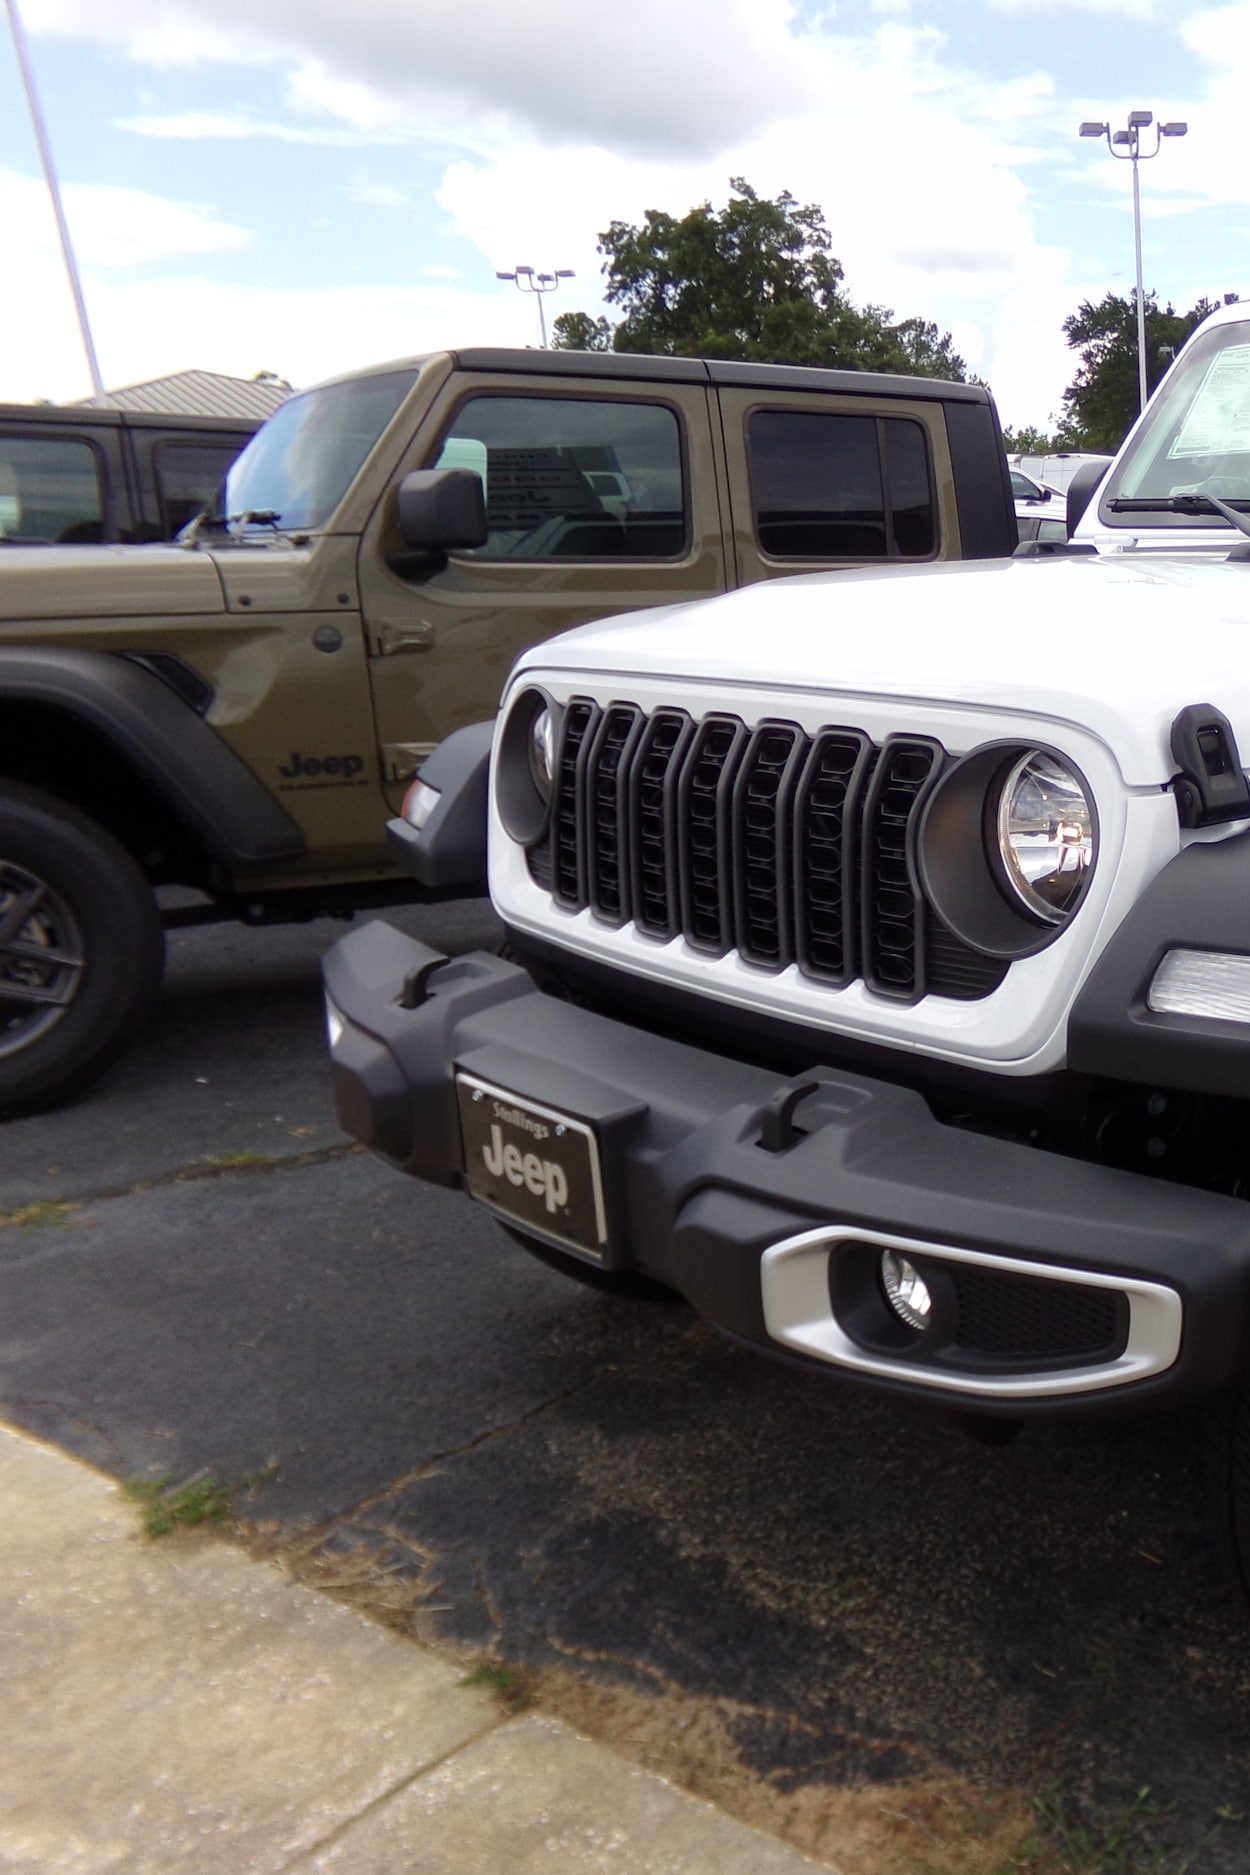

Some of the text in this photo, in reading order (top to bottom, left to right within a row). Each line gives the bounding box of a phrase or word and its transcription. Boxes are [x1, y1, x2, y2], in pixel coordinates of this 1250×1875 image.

[279, 752, 363, 777] Jeep
[493, 1102, 549, 1139] Stallings
[482, 1124, 568, 1213] Jeep
